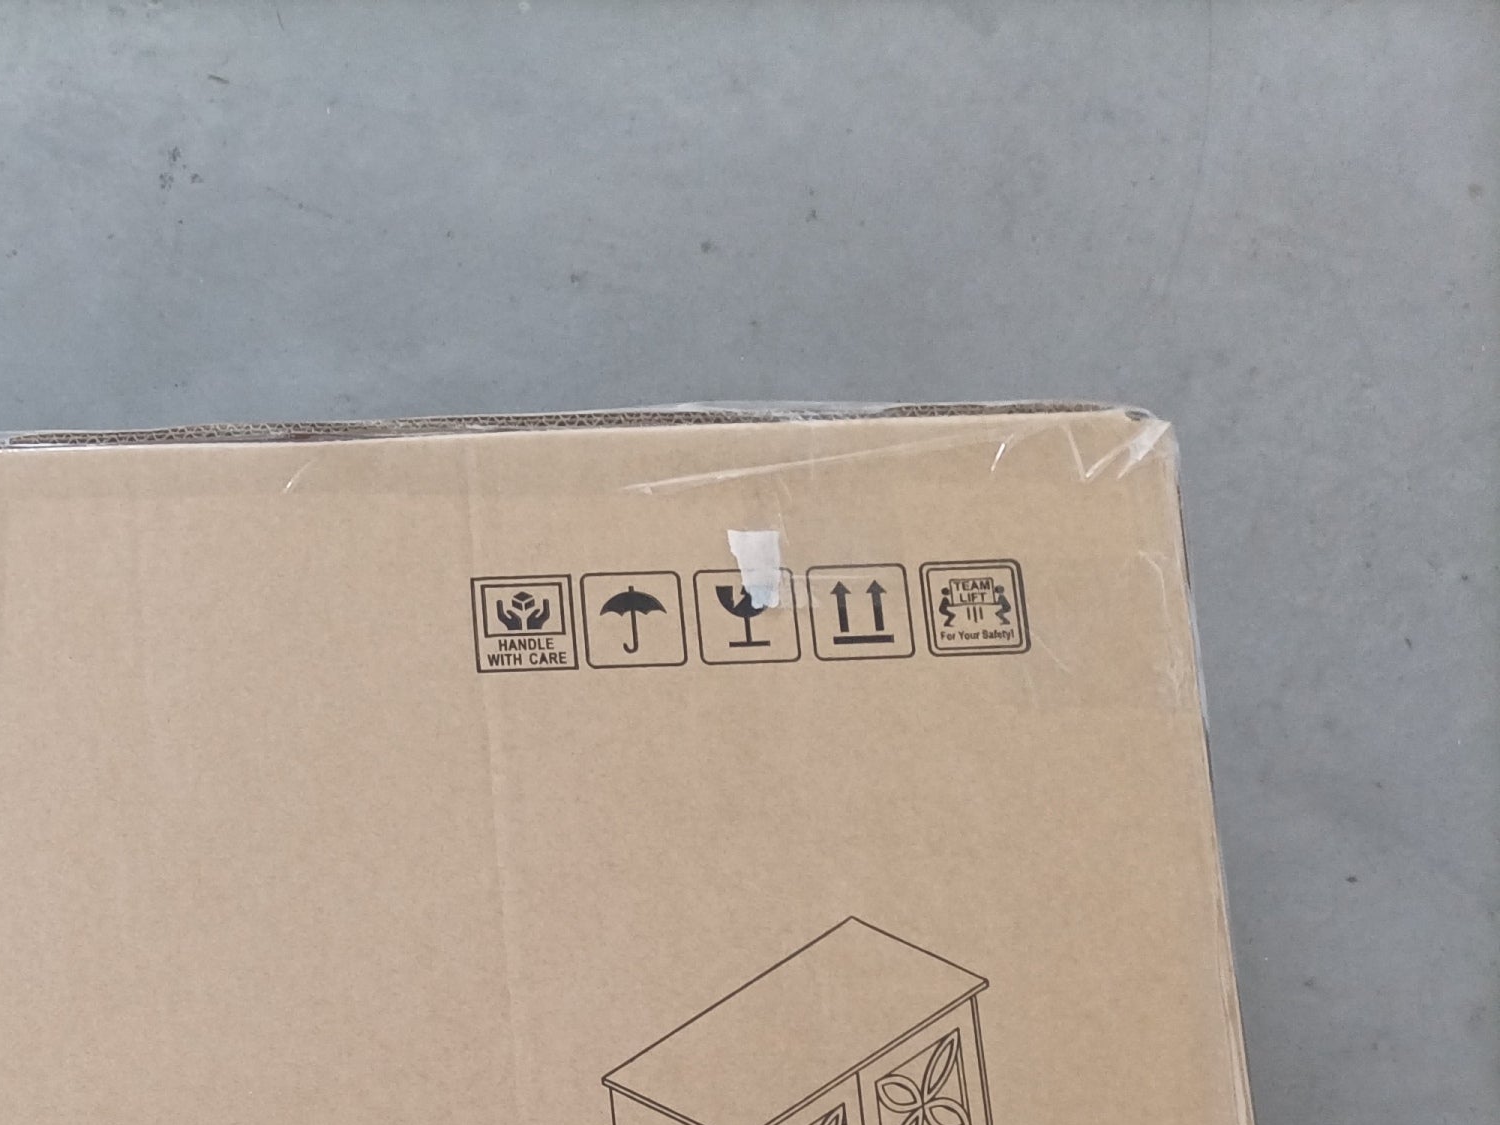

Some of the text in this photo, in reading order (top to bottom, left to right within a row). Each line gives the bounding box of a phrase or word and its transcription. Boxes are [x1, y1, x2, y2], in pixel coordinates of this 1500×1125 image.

[953, 580, 991, 591] TEAM
[959, 592, 987, 602] LIFT
[940, 631, 956, 640] For
[958, 631, 980, 640] Your
[498, 637, 555, 651] HANDLE
[487, 651, 567, 666] WITH CARE
